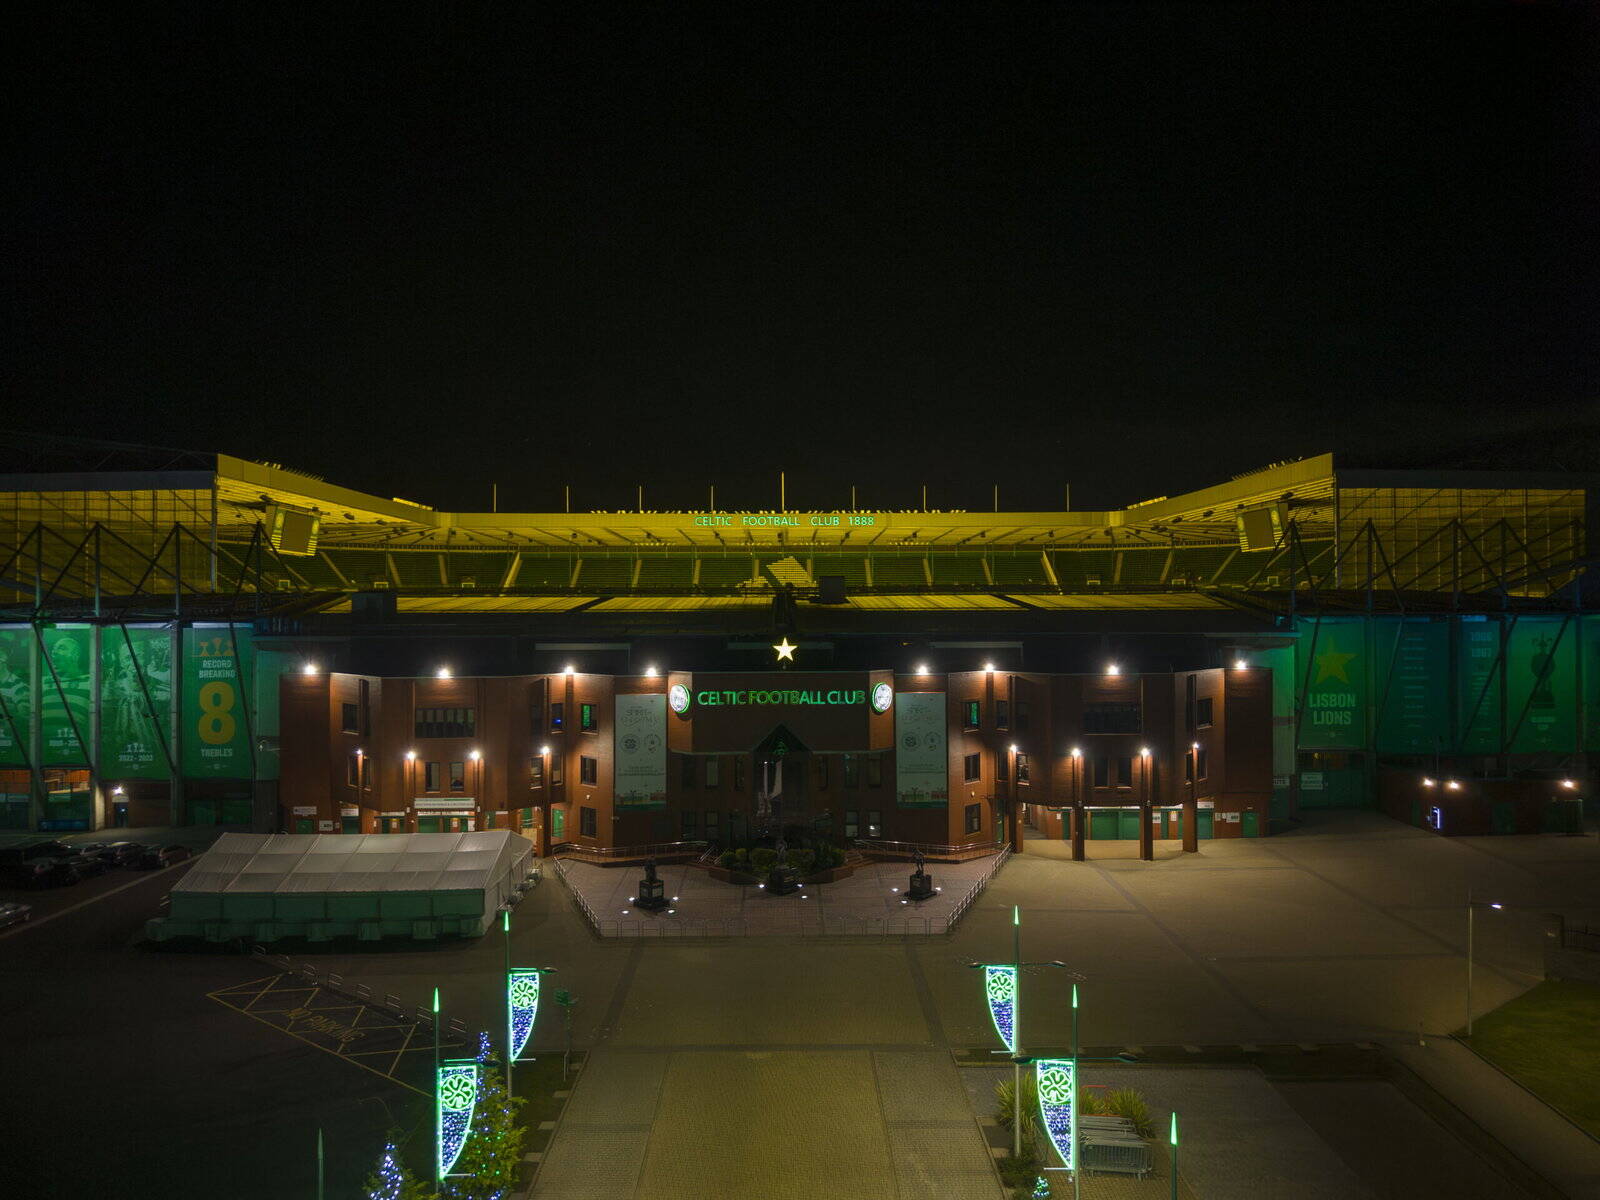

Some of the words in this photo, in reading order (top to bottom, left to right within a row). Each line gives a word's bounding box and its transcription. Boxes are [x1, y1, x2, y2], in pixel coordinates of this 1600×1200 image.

[695, 516, 732, 526] CELTIC
[743, 516, 800, 526] FOOTBALL
[811, 516, 840, 526] CLUB
[849, 516, 874, 526] 1888
[202, 659, 232, 669] RECORD
[198, 669, 236, 679] BREAKING
[697, 690, 747, 706] CELTIC
[748, 690, 826, 705] FOOTBALL
[827, 690, 866, 705] CLUB
[1308, 692, 1356, 708] LISBON
[198, 680, 236, 745] 8
[1313, 710, 1352, 725] LIONS
[200, 748, 233, 757] TREBLES
